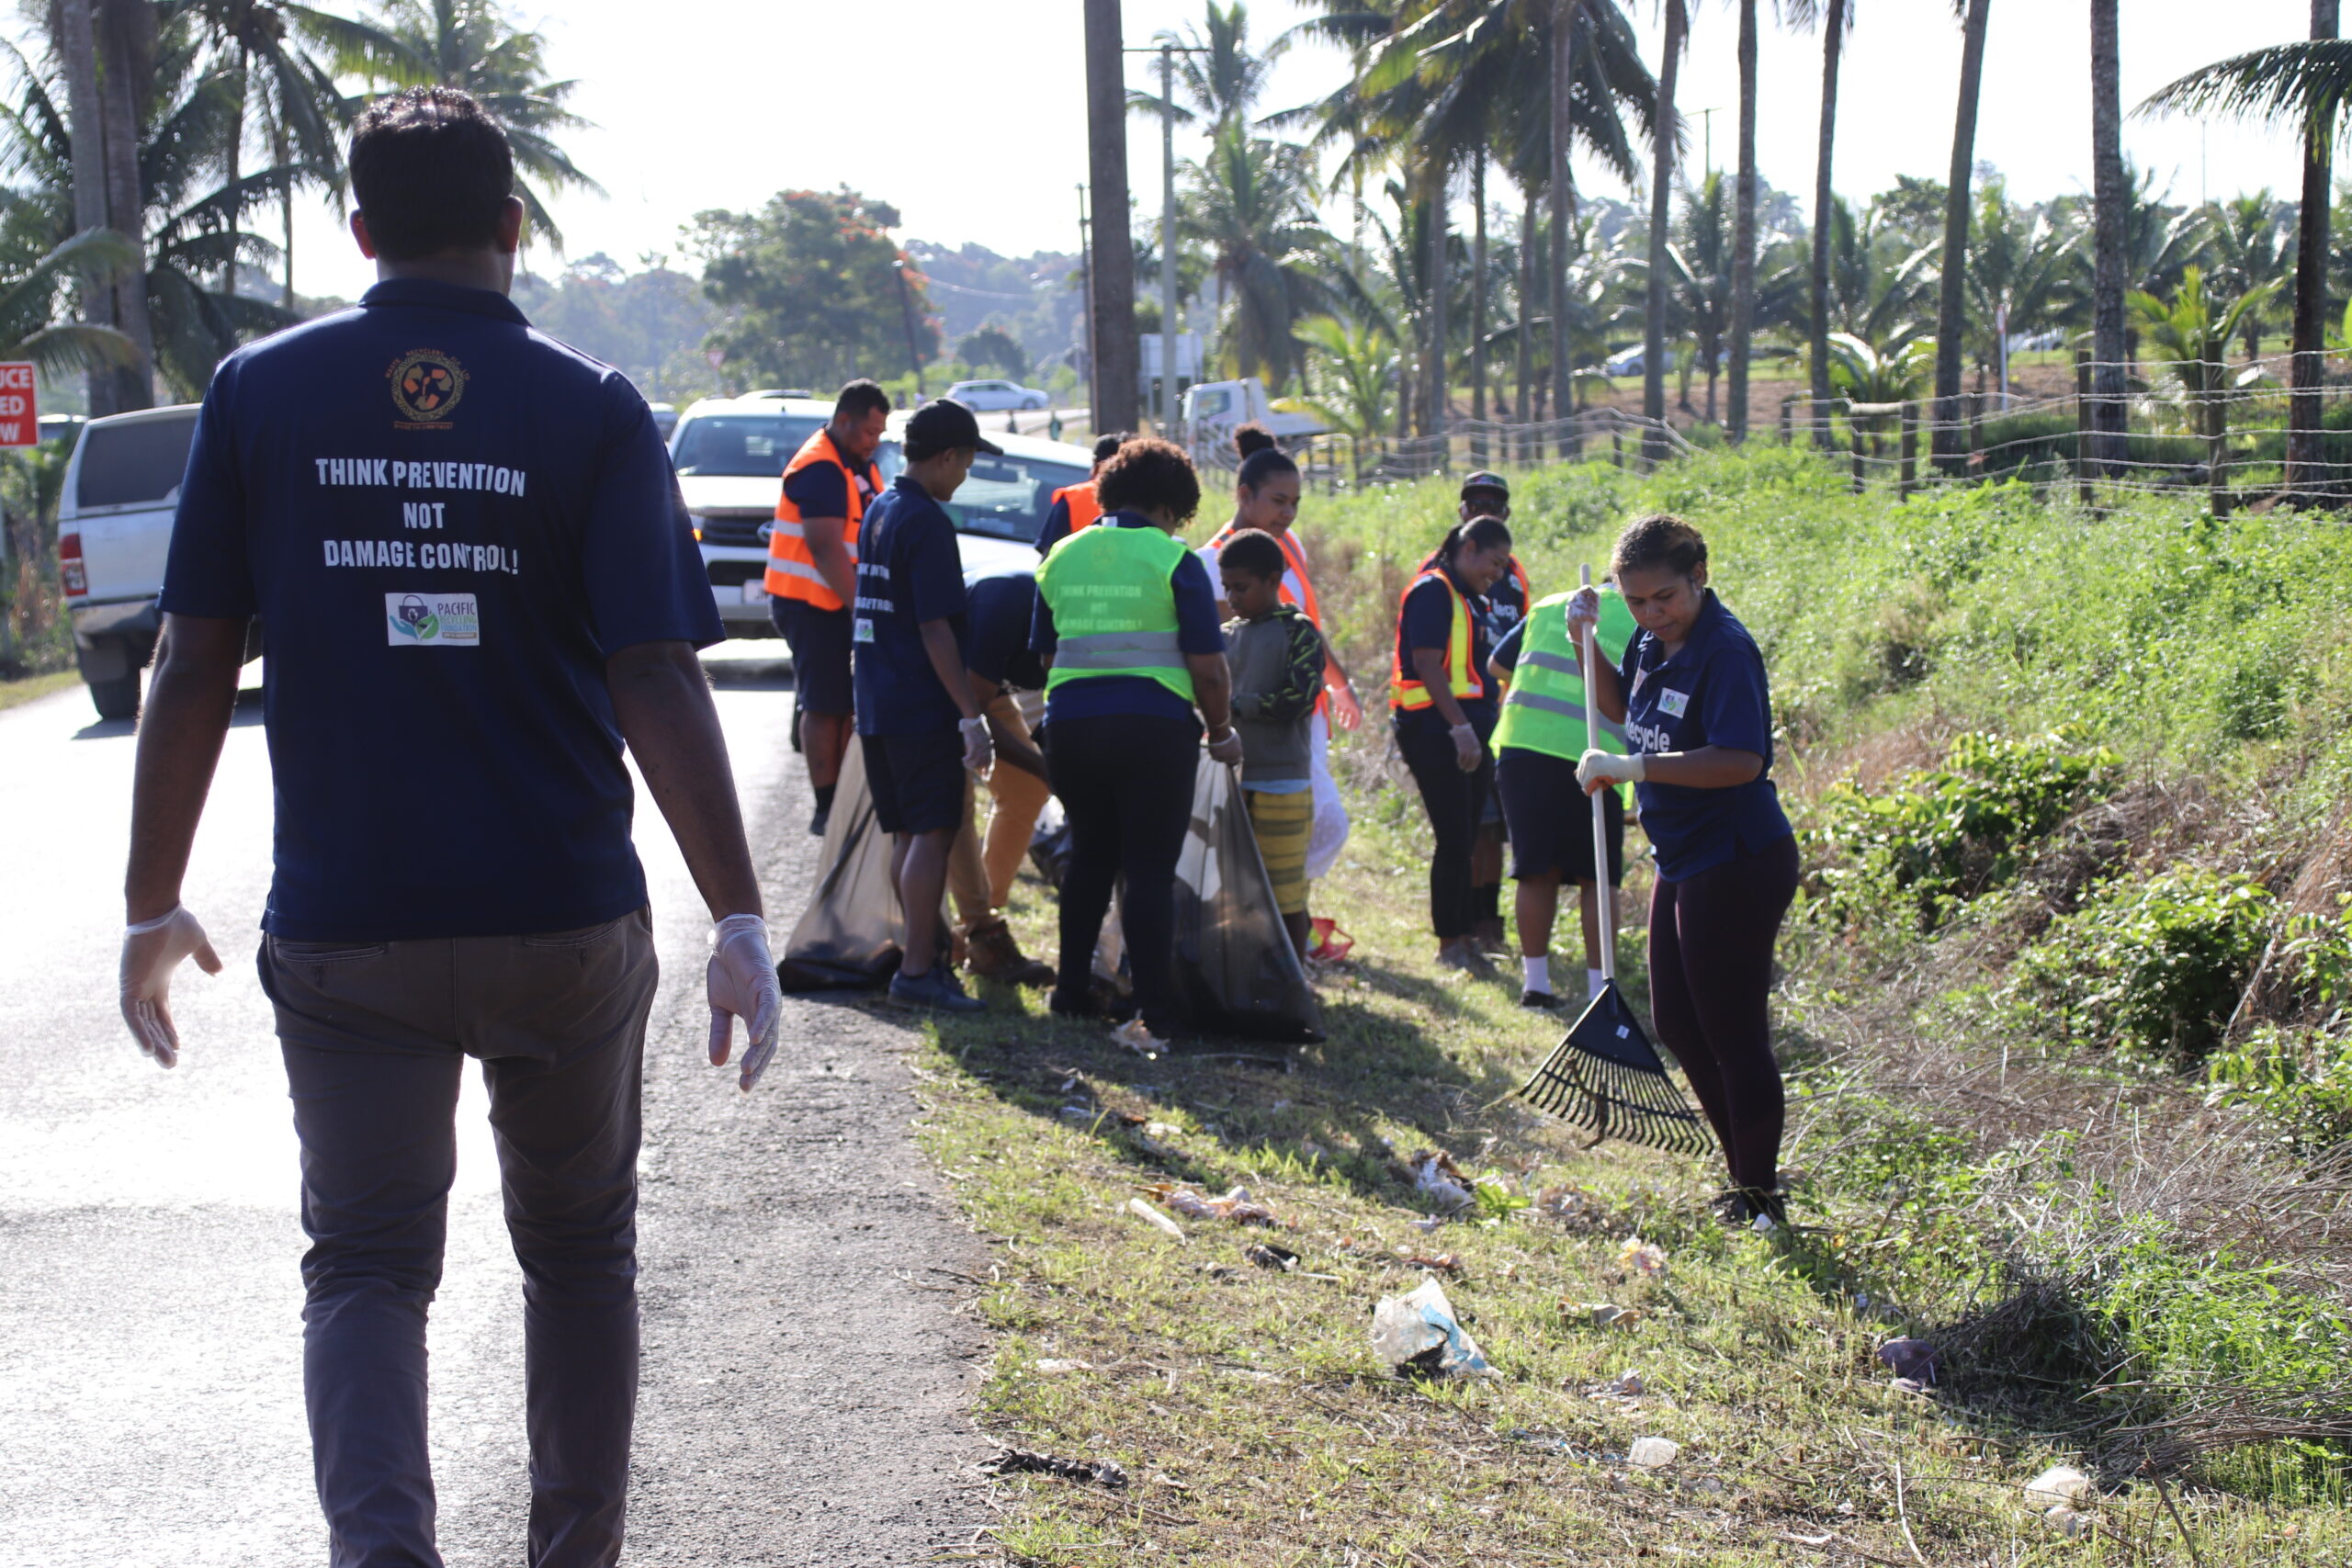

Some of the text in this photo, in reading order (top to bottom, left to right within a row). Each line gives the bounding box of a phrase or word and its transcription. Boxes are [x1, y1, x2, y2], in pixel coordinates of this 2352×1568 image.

[315, 458, 525, 497] THINK PREVENTION
[403, 502, 445, 528] NOT
[323, 540, 518, 575] DAMAGE CONTROL!
[1087, 585, 1142, 597] PREVENTION
[437, 603, 476, 615] PACIFIC
[1625, 710, 1670, 753] Recycle
